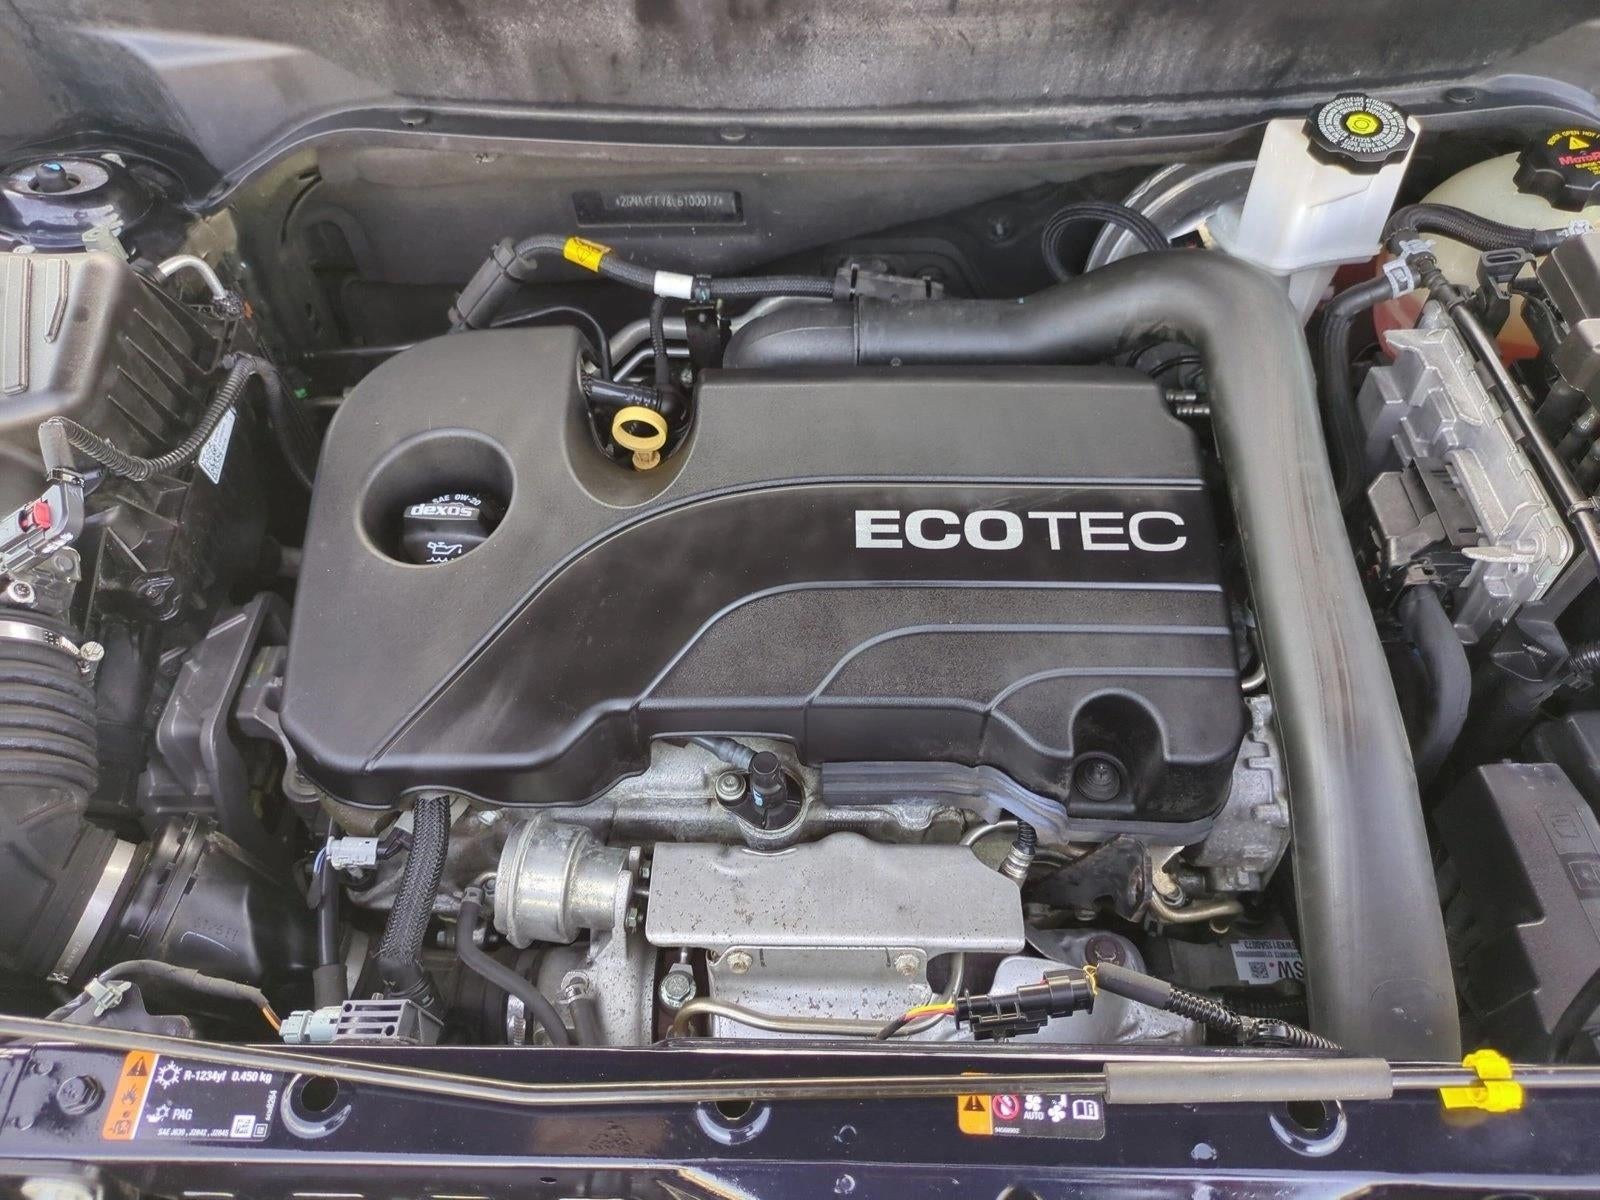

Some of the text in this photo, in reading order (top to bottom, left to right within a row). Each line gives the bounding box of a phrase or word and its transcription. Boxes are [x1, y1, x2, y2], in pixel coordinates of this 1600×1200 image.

[432, 494, 482, 506] SAE 0W-20
[410, 503, 472, 517] dexos
[855, 509, 1188, 551] ECOTEC
[183, 1069, 273, 1085] R-1234yf 0.450 kg
[172, 1108, 194, 1121] PAG
[1023, 1111, 1044, 1120] AUTO
